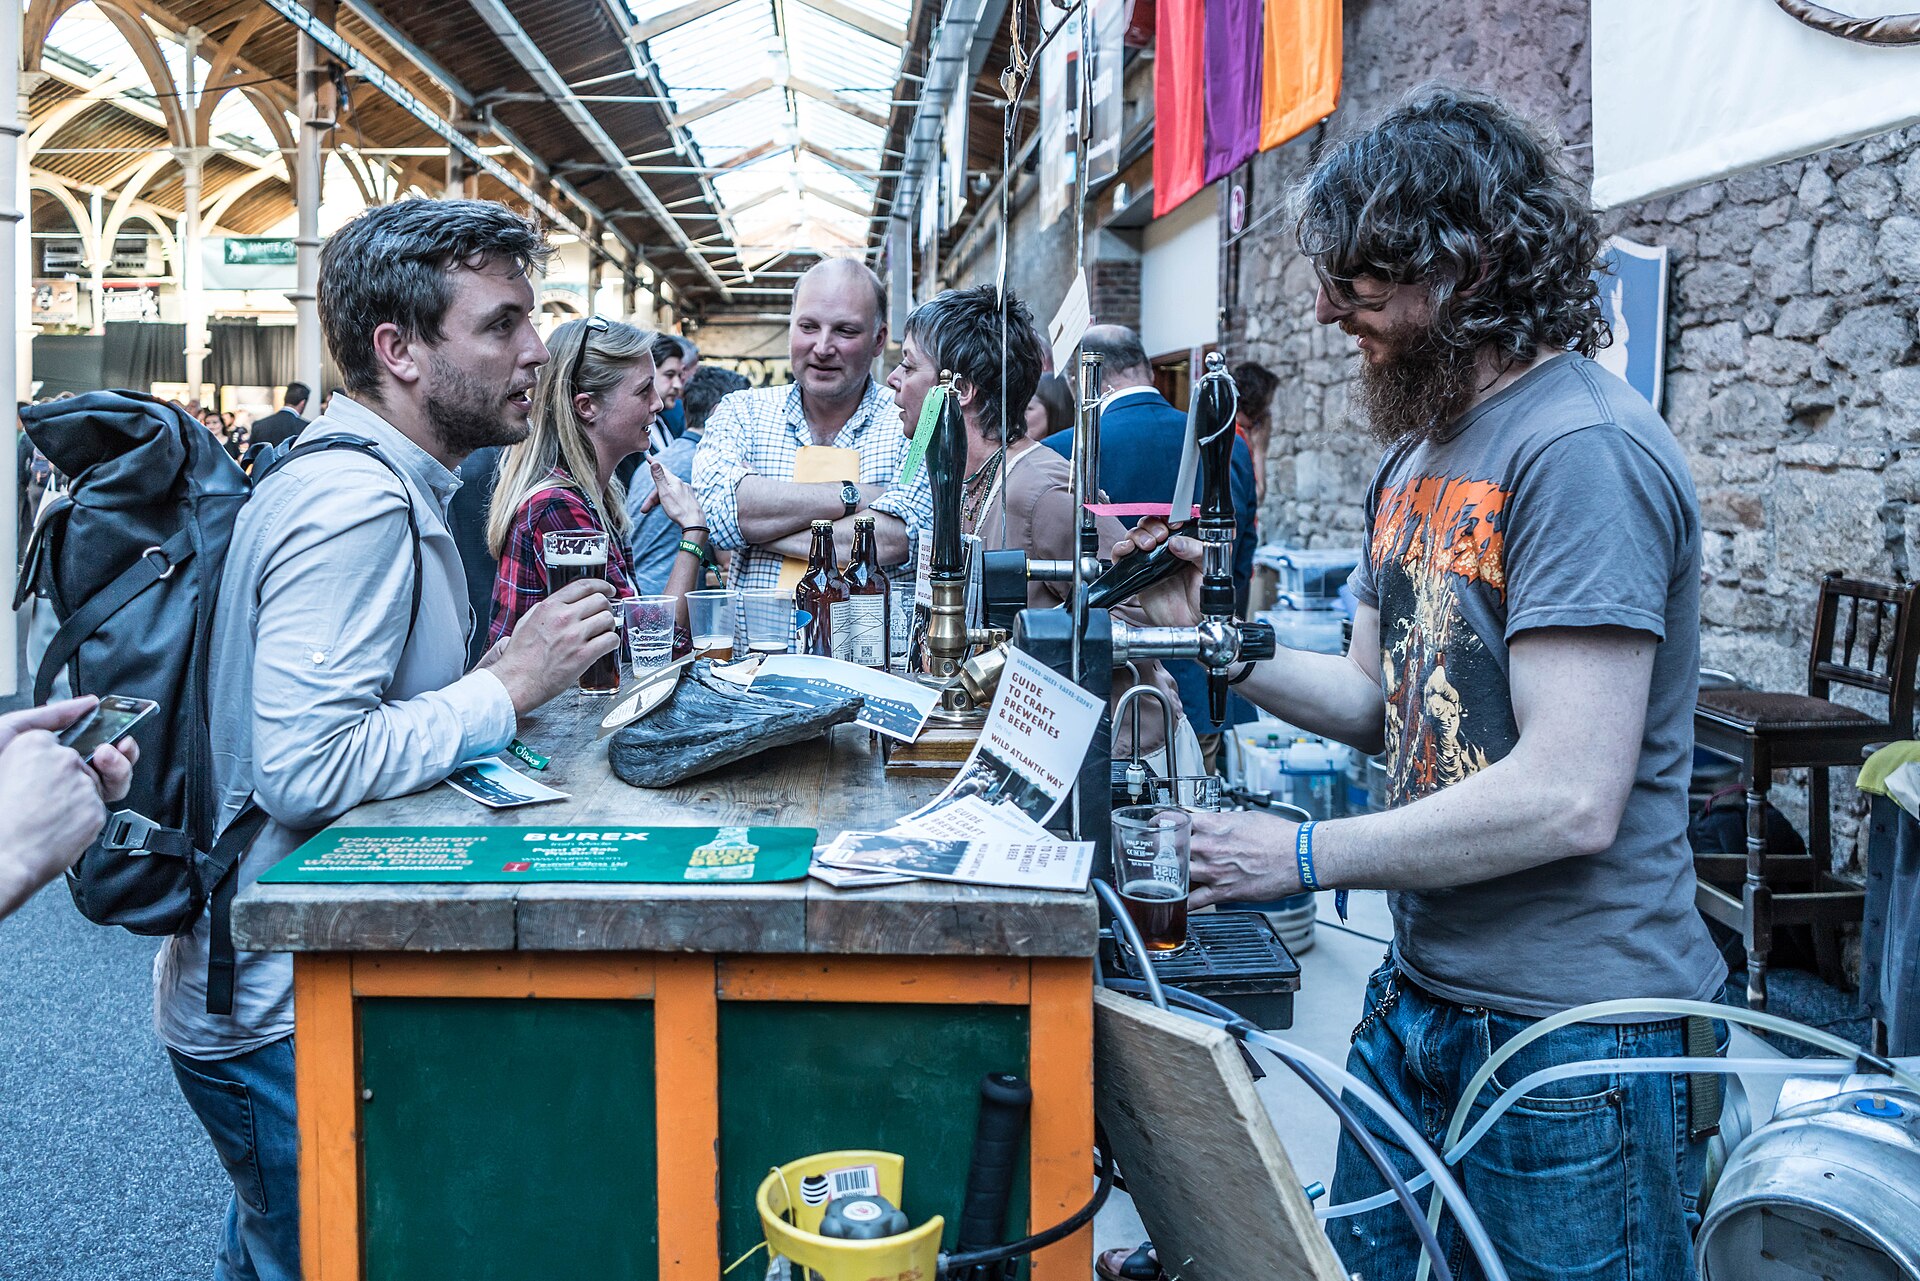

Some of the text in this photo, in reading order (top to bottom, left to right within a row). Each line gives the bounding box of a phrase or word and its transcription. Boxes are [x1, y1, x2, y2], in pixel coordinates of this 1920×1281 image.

[808, 679, 912, 712] WEST KERRY BREWERY
[1012, 672, 1044, 698] GUIDE
[1009, 684, 1056, 720] TO CRAFT
[999, 708, 1032, 736] & BEER
[1004, 696, 1060, 739] BREWERIES
[991, 732, 1064, 789] WILD ATLANTIC WAY
[944, 813, 986, 836] TO CRAFT
[954, 808, 984, 824] GUIDE
[523, 832, 650, 841] BUREX
[1299, 833, 1309, 854] BEER
[1054, 846, 1068, 861] GUIDE
[1301, 856, 1314, 884] CRAFT
